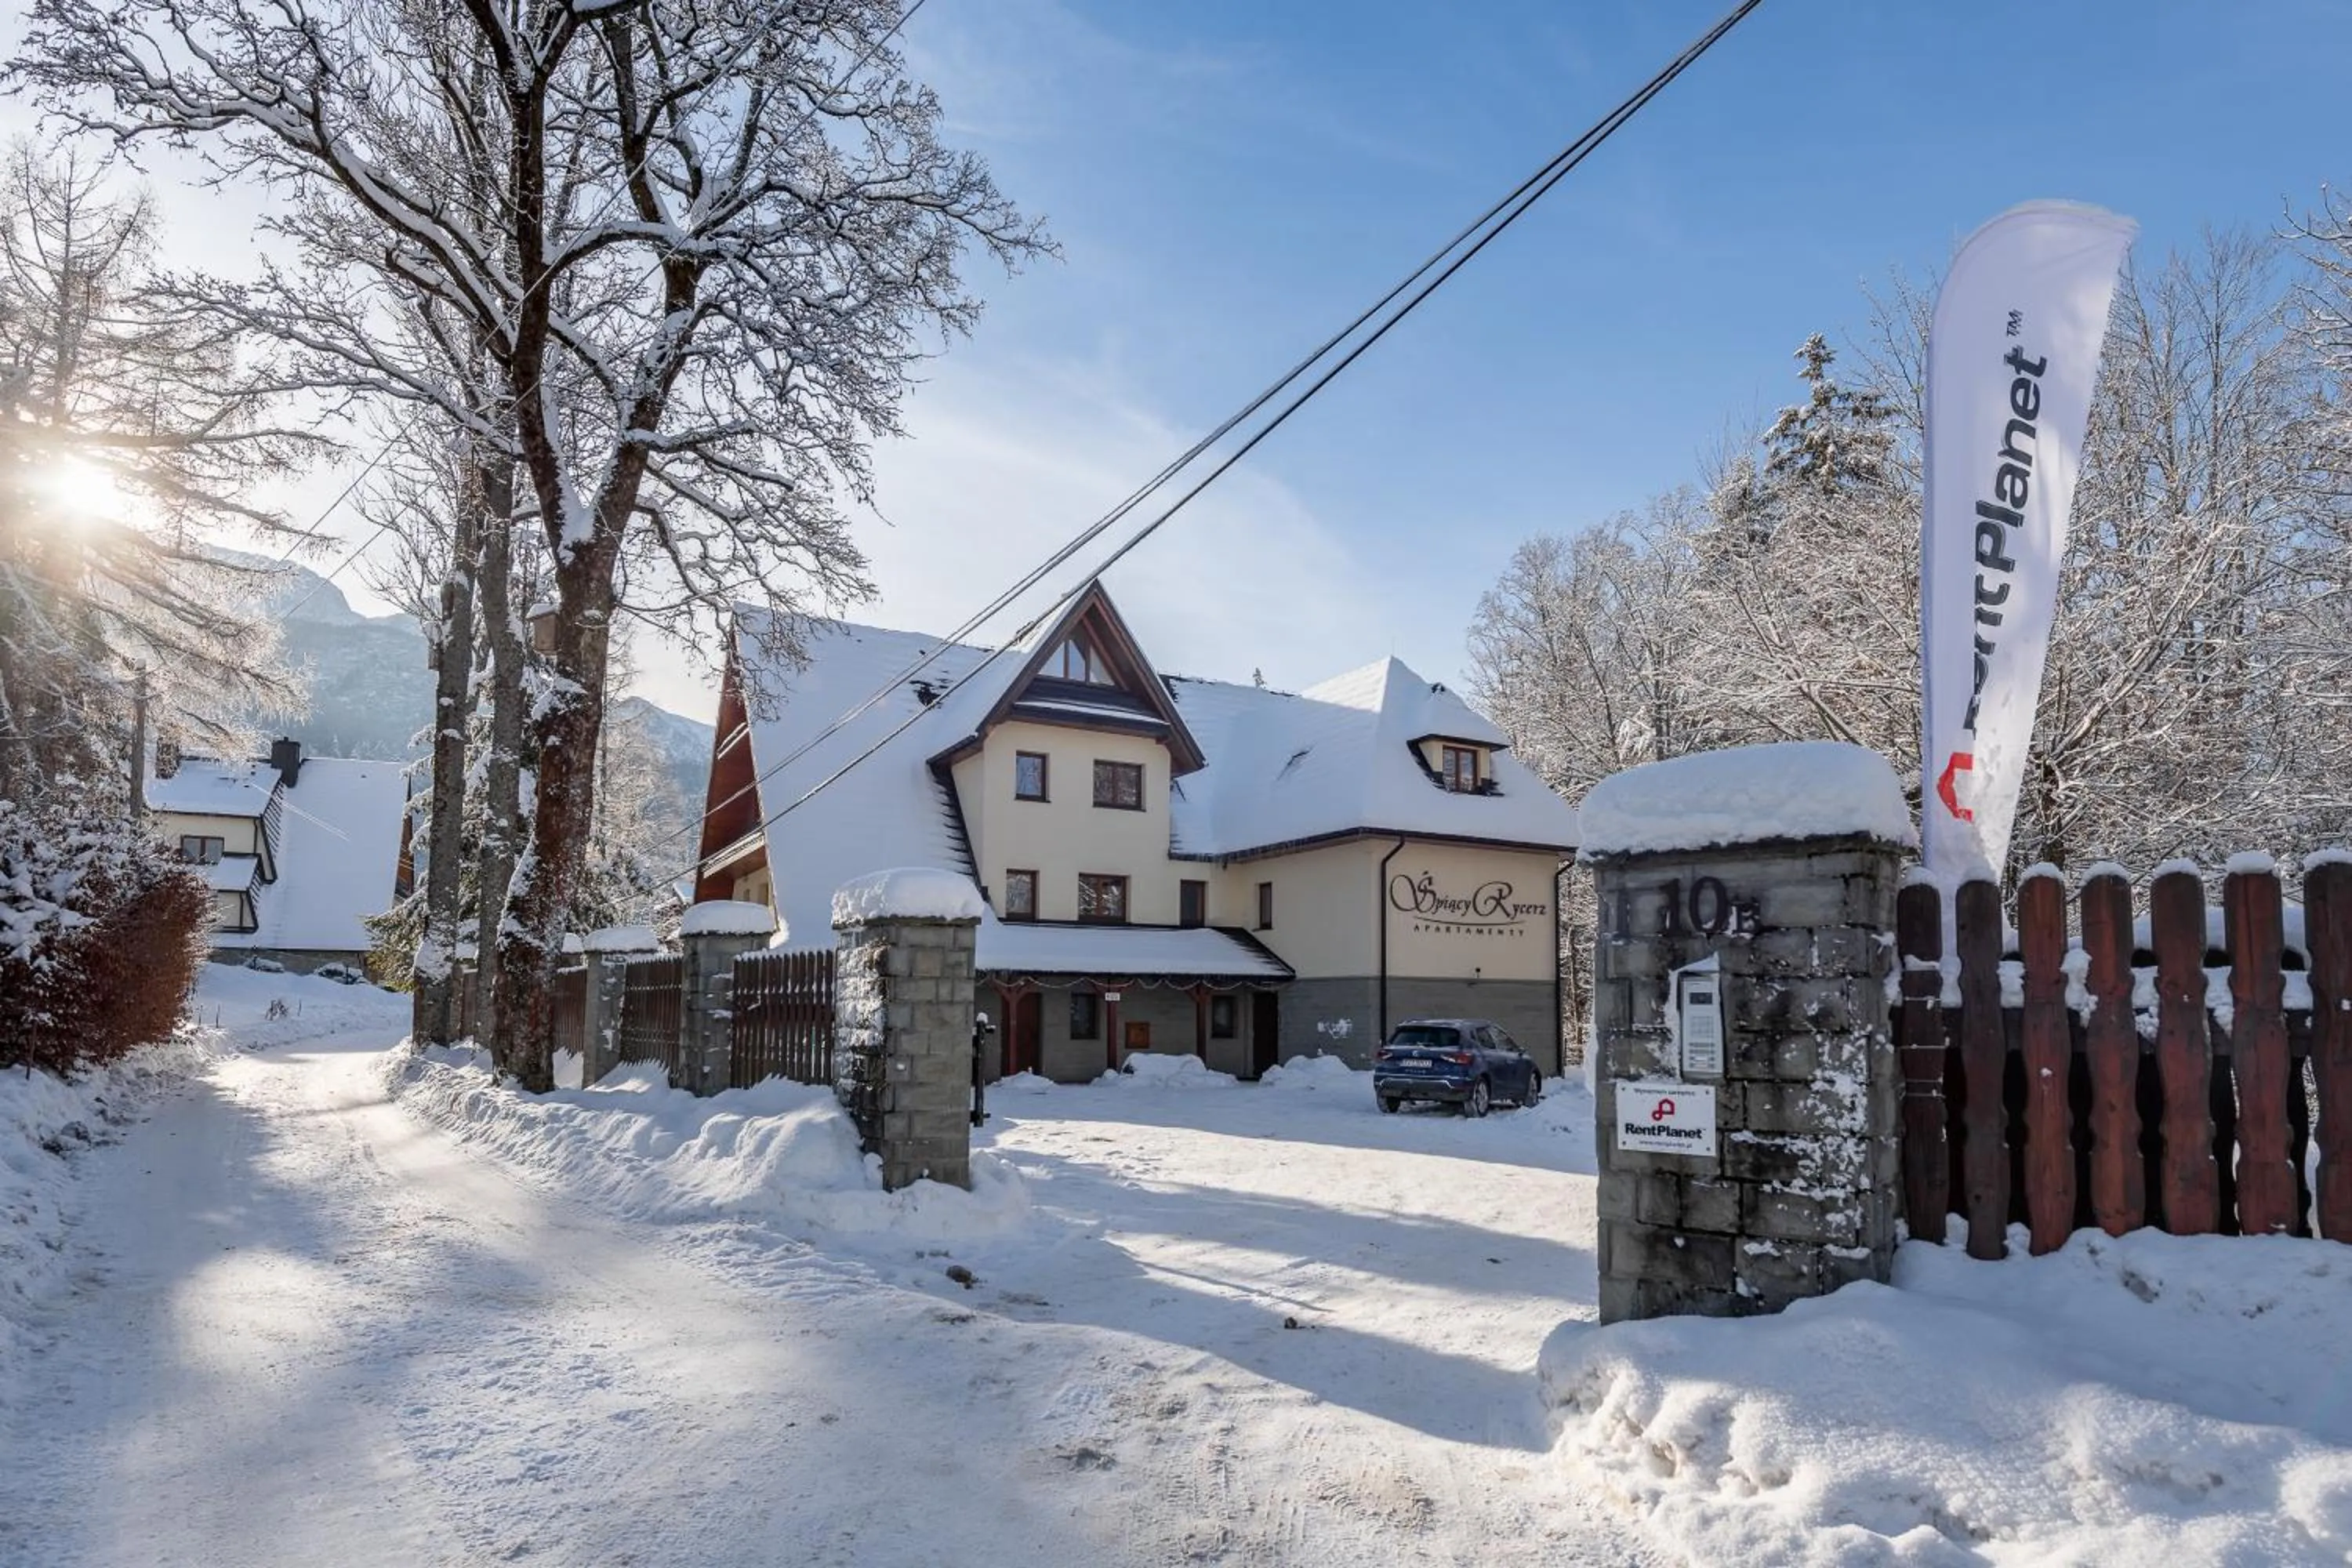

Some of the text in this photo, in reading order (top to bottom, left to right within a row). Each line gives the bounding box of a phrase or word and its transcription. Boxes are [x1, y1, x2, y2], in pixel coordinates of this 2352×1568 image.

[1390, 870, 1547, 920] Śpiący Rycerz
[1414, 924, 1524, 937] APARTAMENTY
[1624, 1122, 1703, 1140] RentPlanet
